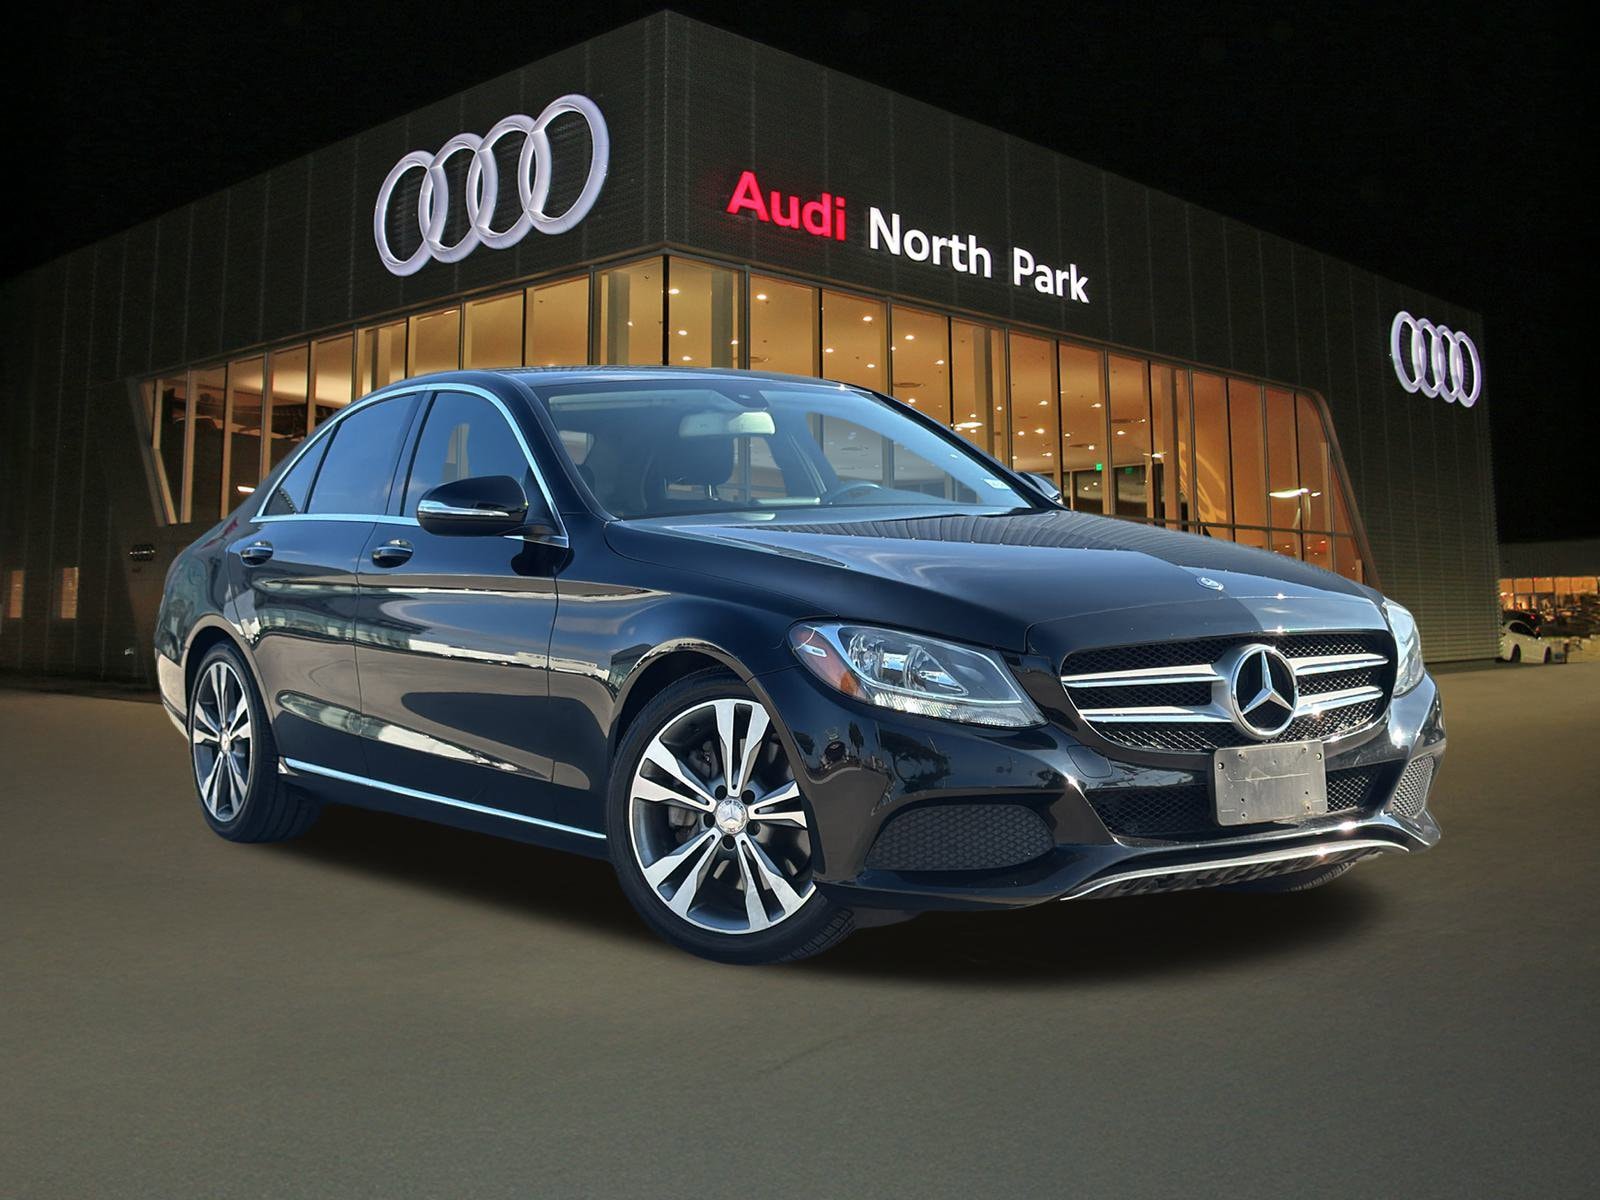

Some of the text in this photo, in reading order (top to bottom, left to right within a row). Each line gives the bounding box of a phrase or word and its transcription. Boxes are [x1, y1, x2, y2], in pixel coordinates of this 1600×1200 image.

[726, 170, 1090, 304] Audi North Park
